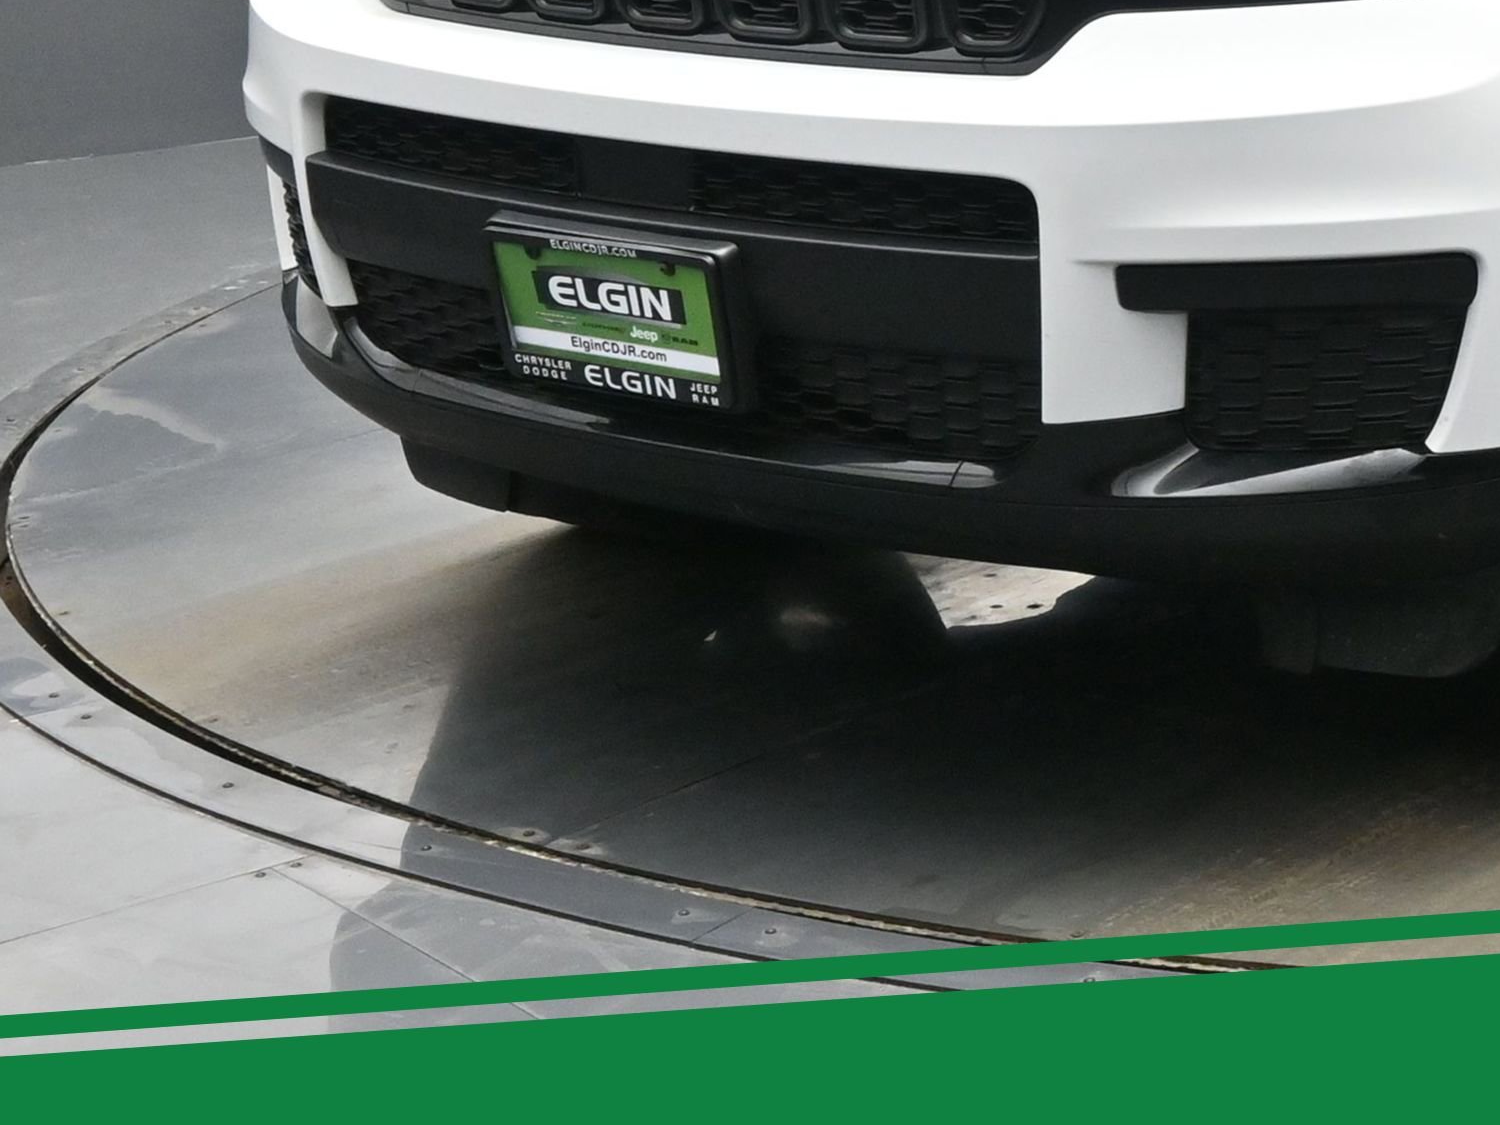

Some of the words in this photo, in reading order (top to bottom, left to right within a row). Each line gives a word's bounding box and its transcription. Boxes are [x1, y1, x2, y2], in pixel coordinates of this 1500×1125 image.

[549, 238, 637, 259] ELGINCDJR.COM
[548, 274, 673, 321] ELGIN
[629, 325, 659, 343] Jeep
[570, 335, 668, 363] ElginCDJR.com
[514, 353, 572, 371] CHRYSLER
[522, 364, 568, 381] DODGE
[583, 364, 677, 400] ELGIN
[689, 382, 718, 395] JEEP
[691, 393, 720, 407] RAM
